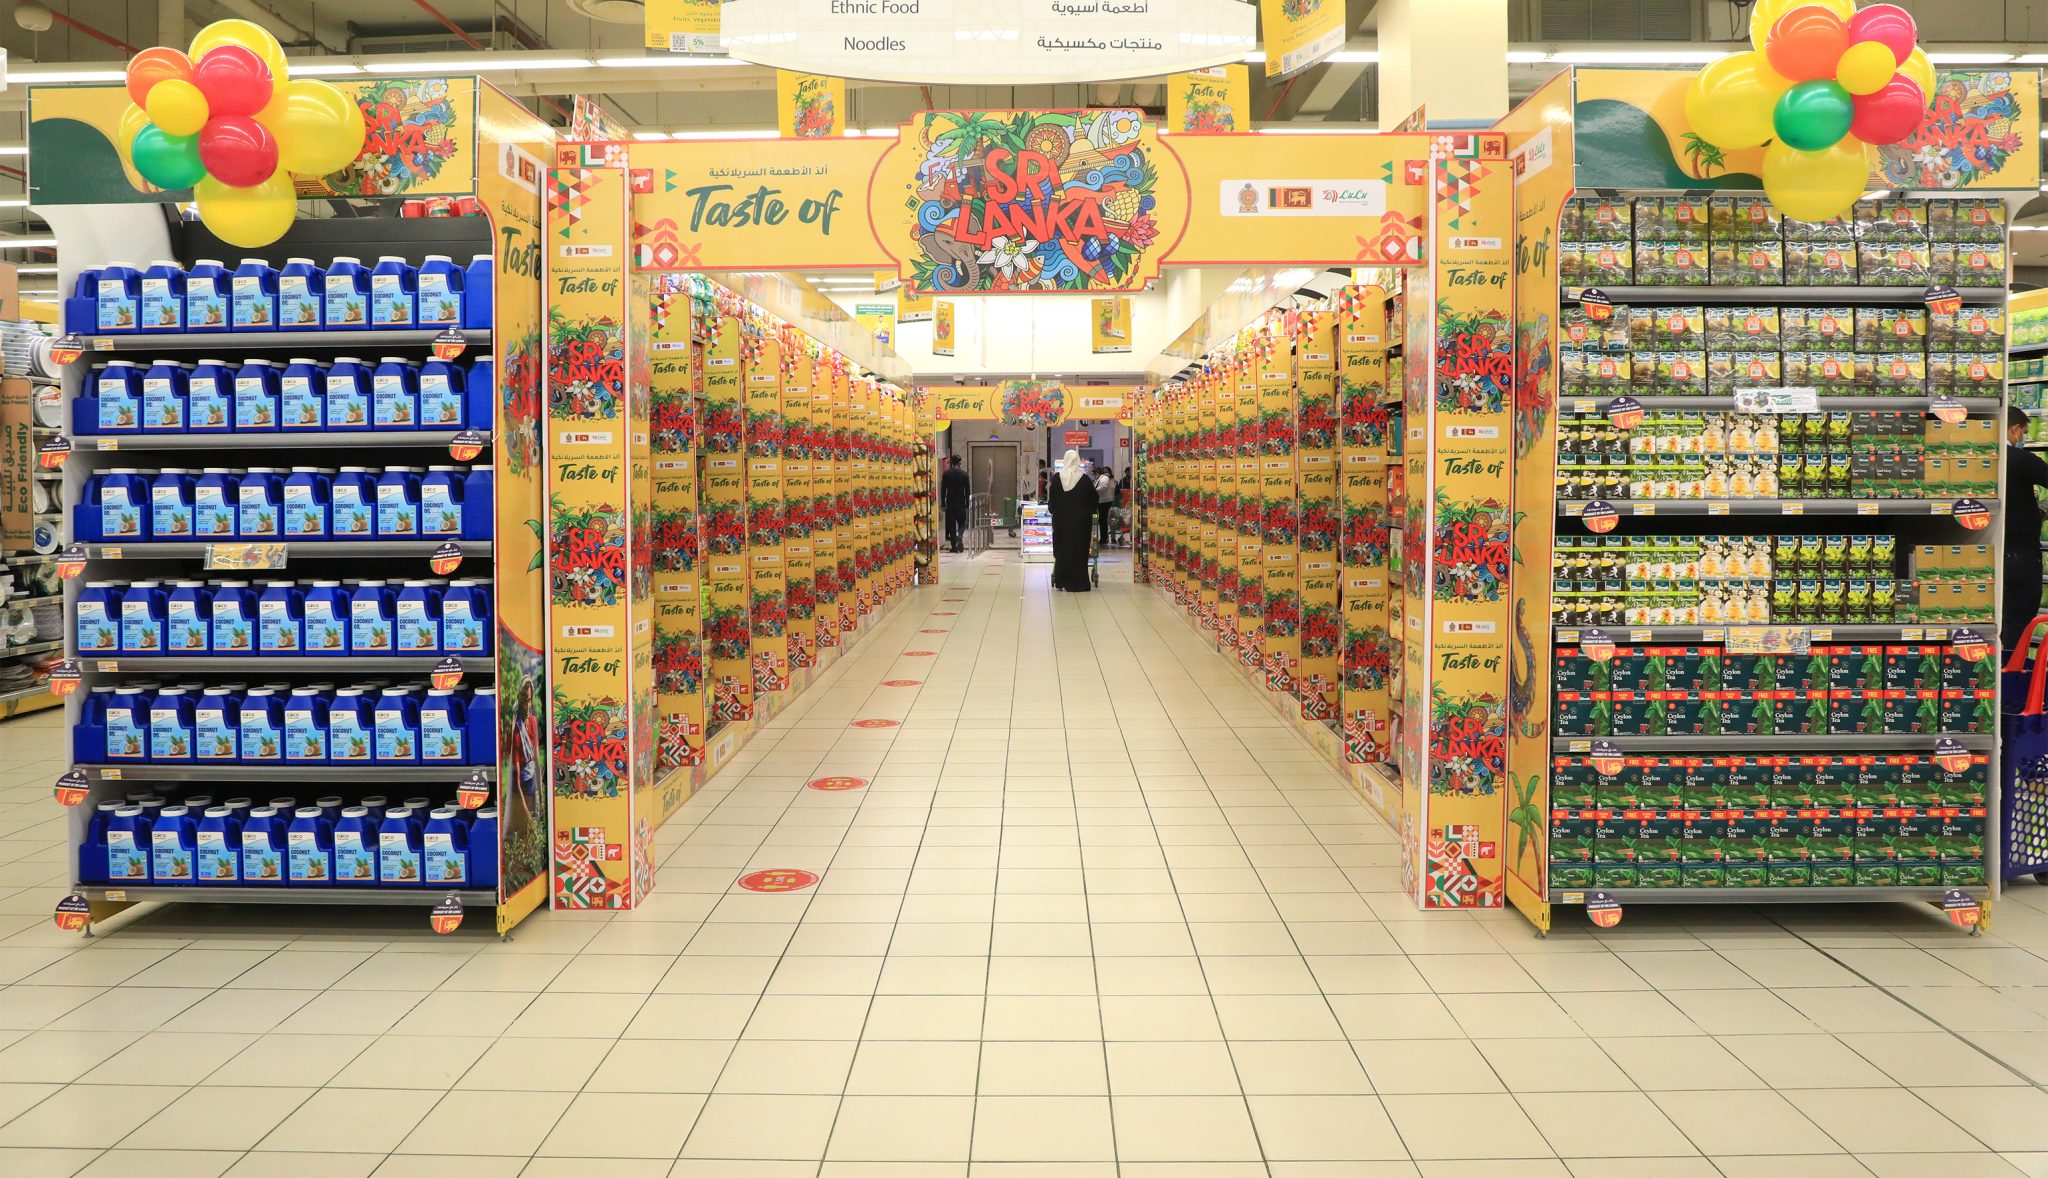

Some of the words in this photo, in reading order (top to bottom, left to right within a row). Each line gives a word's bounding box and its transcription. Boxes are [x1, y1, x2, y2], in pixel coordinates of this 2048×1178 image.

[831, 0, 877, 14] Ethnic
[882, 0, 920, 14] Food
[844, 37, 906, 51] Noodles
[1037, 36, 1106, 52] مكسيكية
[1110, 37, 1162, 53] منتجات
[798, 79, 819, 95] Taste
[1190, 83, 1215, 97] Taste
[1217, 88, 1228, 100] of
[709, 168, 766, 179] السريلانكية
[770, 167, 811, 176] الأطعمة
[815, 165, 828, 175] ألذ
[985, 149, 1067, 203] SRI
[1339, 190, 1368, 199] LuLu
[686, 185, 789, 232] Taste
[798, 189, 843, 235] of
[955, 196, 1110, 251] LANKA
[559, 276, 597, 295] Taste
[602, 279, 619, 296] of
[1447, 269, 1487, 287] Taste
[1491, 271, 1508, 289] of
[569, 340, 604, 365] SRI
[1457, 333, 1492, 358] SRI
[653, 362, 676, 374] Taste
[679, 363, 688, 375] of
[1347, 355, 1372, 367] Taste
[1374, 356, 1383, 368] of
[1443, 357, 1511, 380] LANKA
[556, 363, 624, 386] LANKA
[707, 376, 727, 386] Taste
[729, 377, 738, 386] of
[1303, 371, 1323, 382] Taste
[1324, 372, 1332, 382] of
[944, 397, 970, 410] Taste
[973, 400, 984, 411] of
[17, 423, 28, 482] Friendly
[559, 464, 598, 482] Taste
[602, 466, 619, 483] of
[1444, 457, 1484, 476] Taste
[1487, 461, 1504, 478] of
[656, 481, 680, 493] Taste
[682, 482, 692, 494] of
[710, 477, 732, 488] Taste
[733, 478, 740, 488] of
[1304, 474, 1323, 485] Taste
[1324, 475, 1333, 485] of
[1348, 475, 1372, 487] Taste
[1373, 476, 1384, 488] of
[19, 486, 28, 514] Eco
[570, 527, 604, 552] SRI
[1454, 522, 1489, 547] SRI
[556, 550, 624, 573] LANKA
[1439, 546, 1508, 568] LANKA
[715, 583, 736, 593] Taste
[737, 584, 743, 594] of
[660, 605, 684, 616] Taste
[686, 605, 696, 616] of
[1350, 600, 1372, 612] Taste
[1375, 601, 1385, 612] of
[561, 656, 601, 675] Taste
[604, 659, 621, 676] of
[1441, 653, 1481, 671] Taste
[1484, 656, 1501, 673] of
[572, 720, 606, 744] SRI
[1449, 716, 1484, 741] SRI
[559, 742, 625, 765] LANKA
[1435, 740, 1503, 762] LANKA
